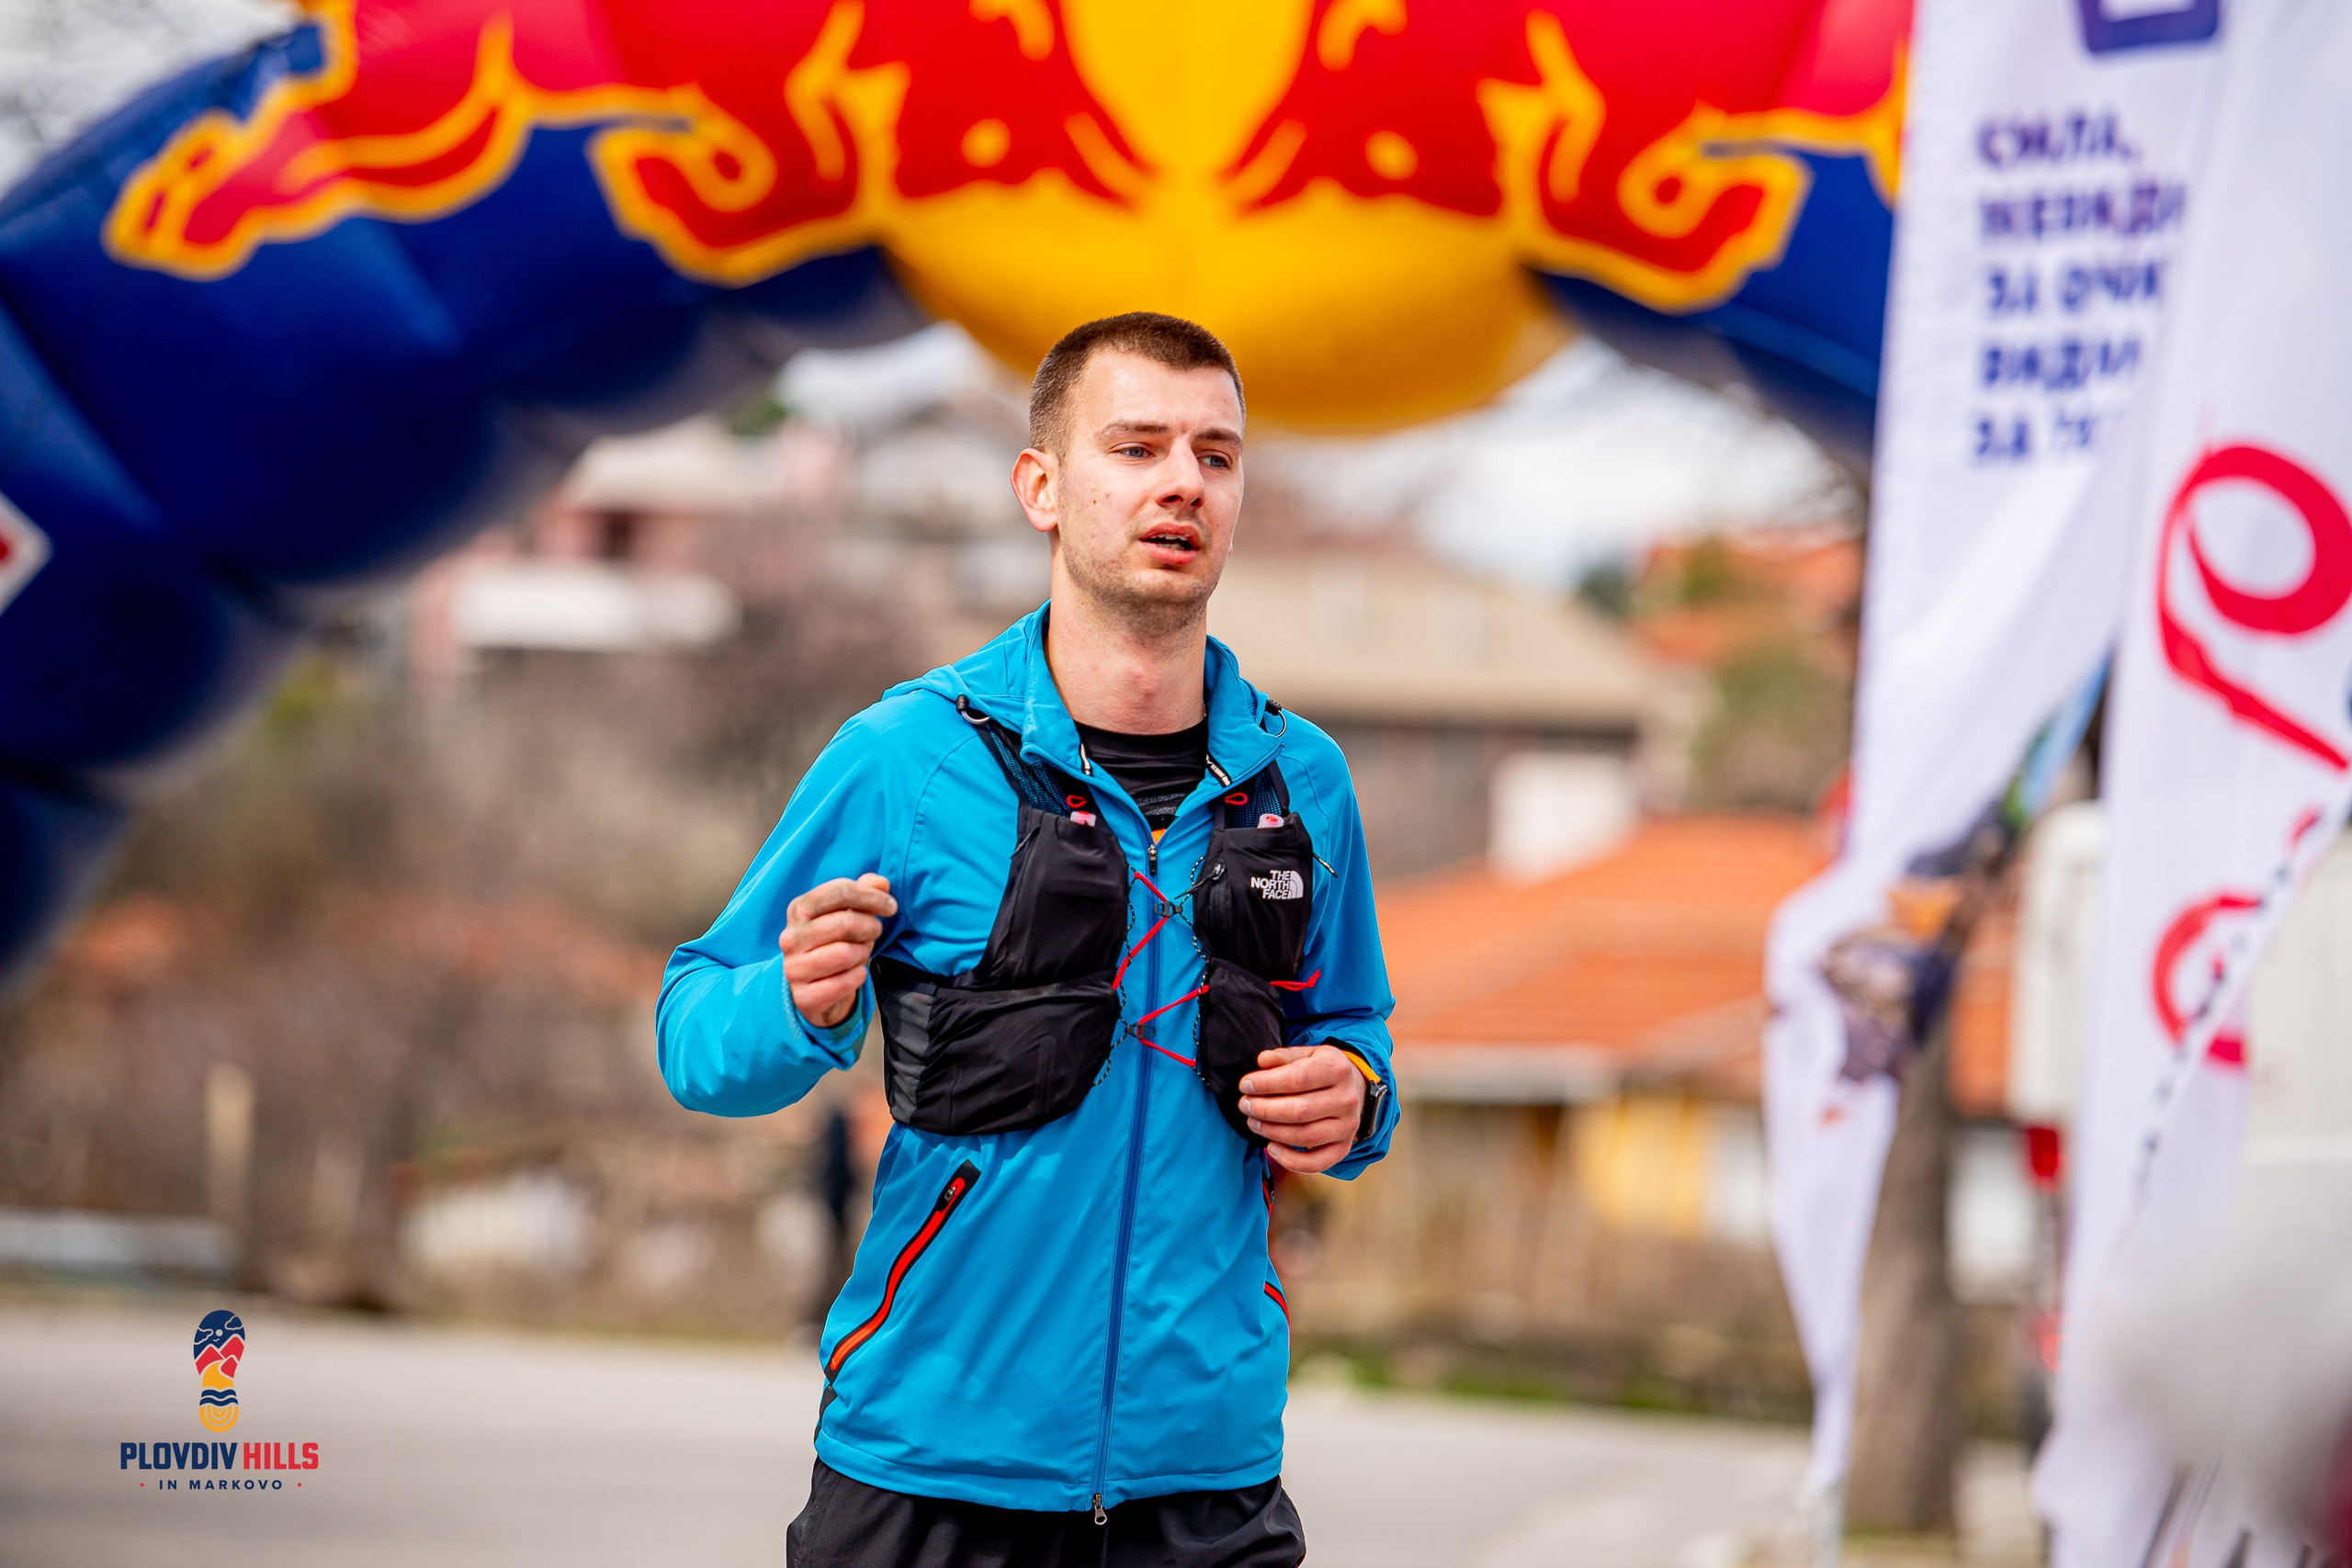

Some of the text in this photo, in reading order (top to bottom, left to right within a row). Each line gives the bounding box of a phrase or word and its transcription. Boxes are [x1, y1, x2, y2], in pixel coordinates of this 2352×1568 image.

[1270, 870, 1290, 880] THE
[1250, 877, 1289, 889] NORTH
[1262, 889, 1287, 899] FACE
